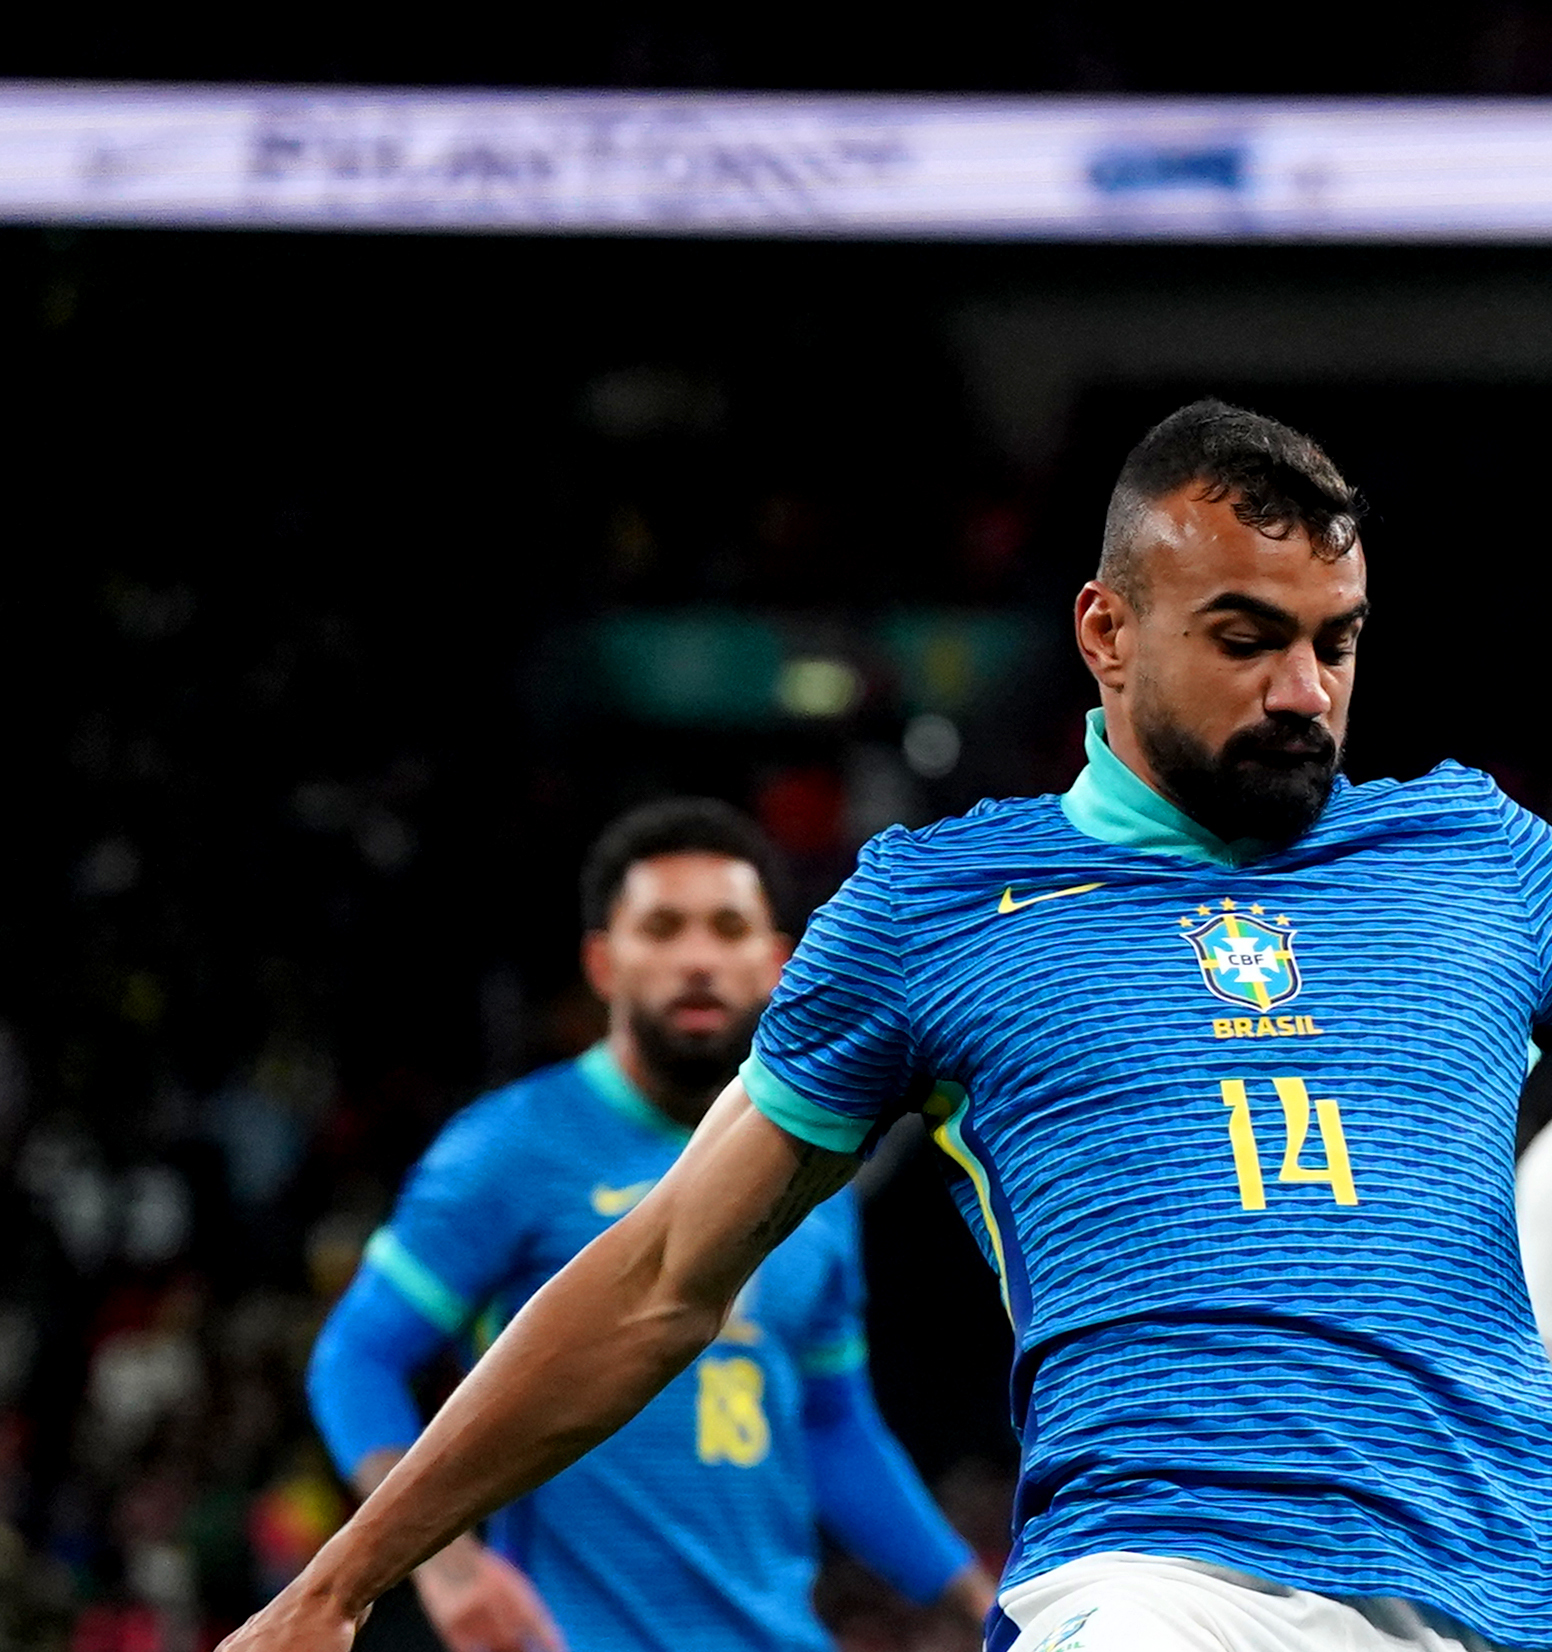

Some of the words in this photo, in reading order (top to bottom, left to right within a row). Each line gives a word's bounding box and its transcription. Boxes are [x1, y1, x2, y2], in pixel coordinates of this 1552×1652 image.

[1228, 954, 1264, 966] CBF
[1213, 1015, 1324, 1039] BRASIL
[1220, 1077, 1358, 1210] 14
[695, 1357, 771, 1468] 18
